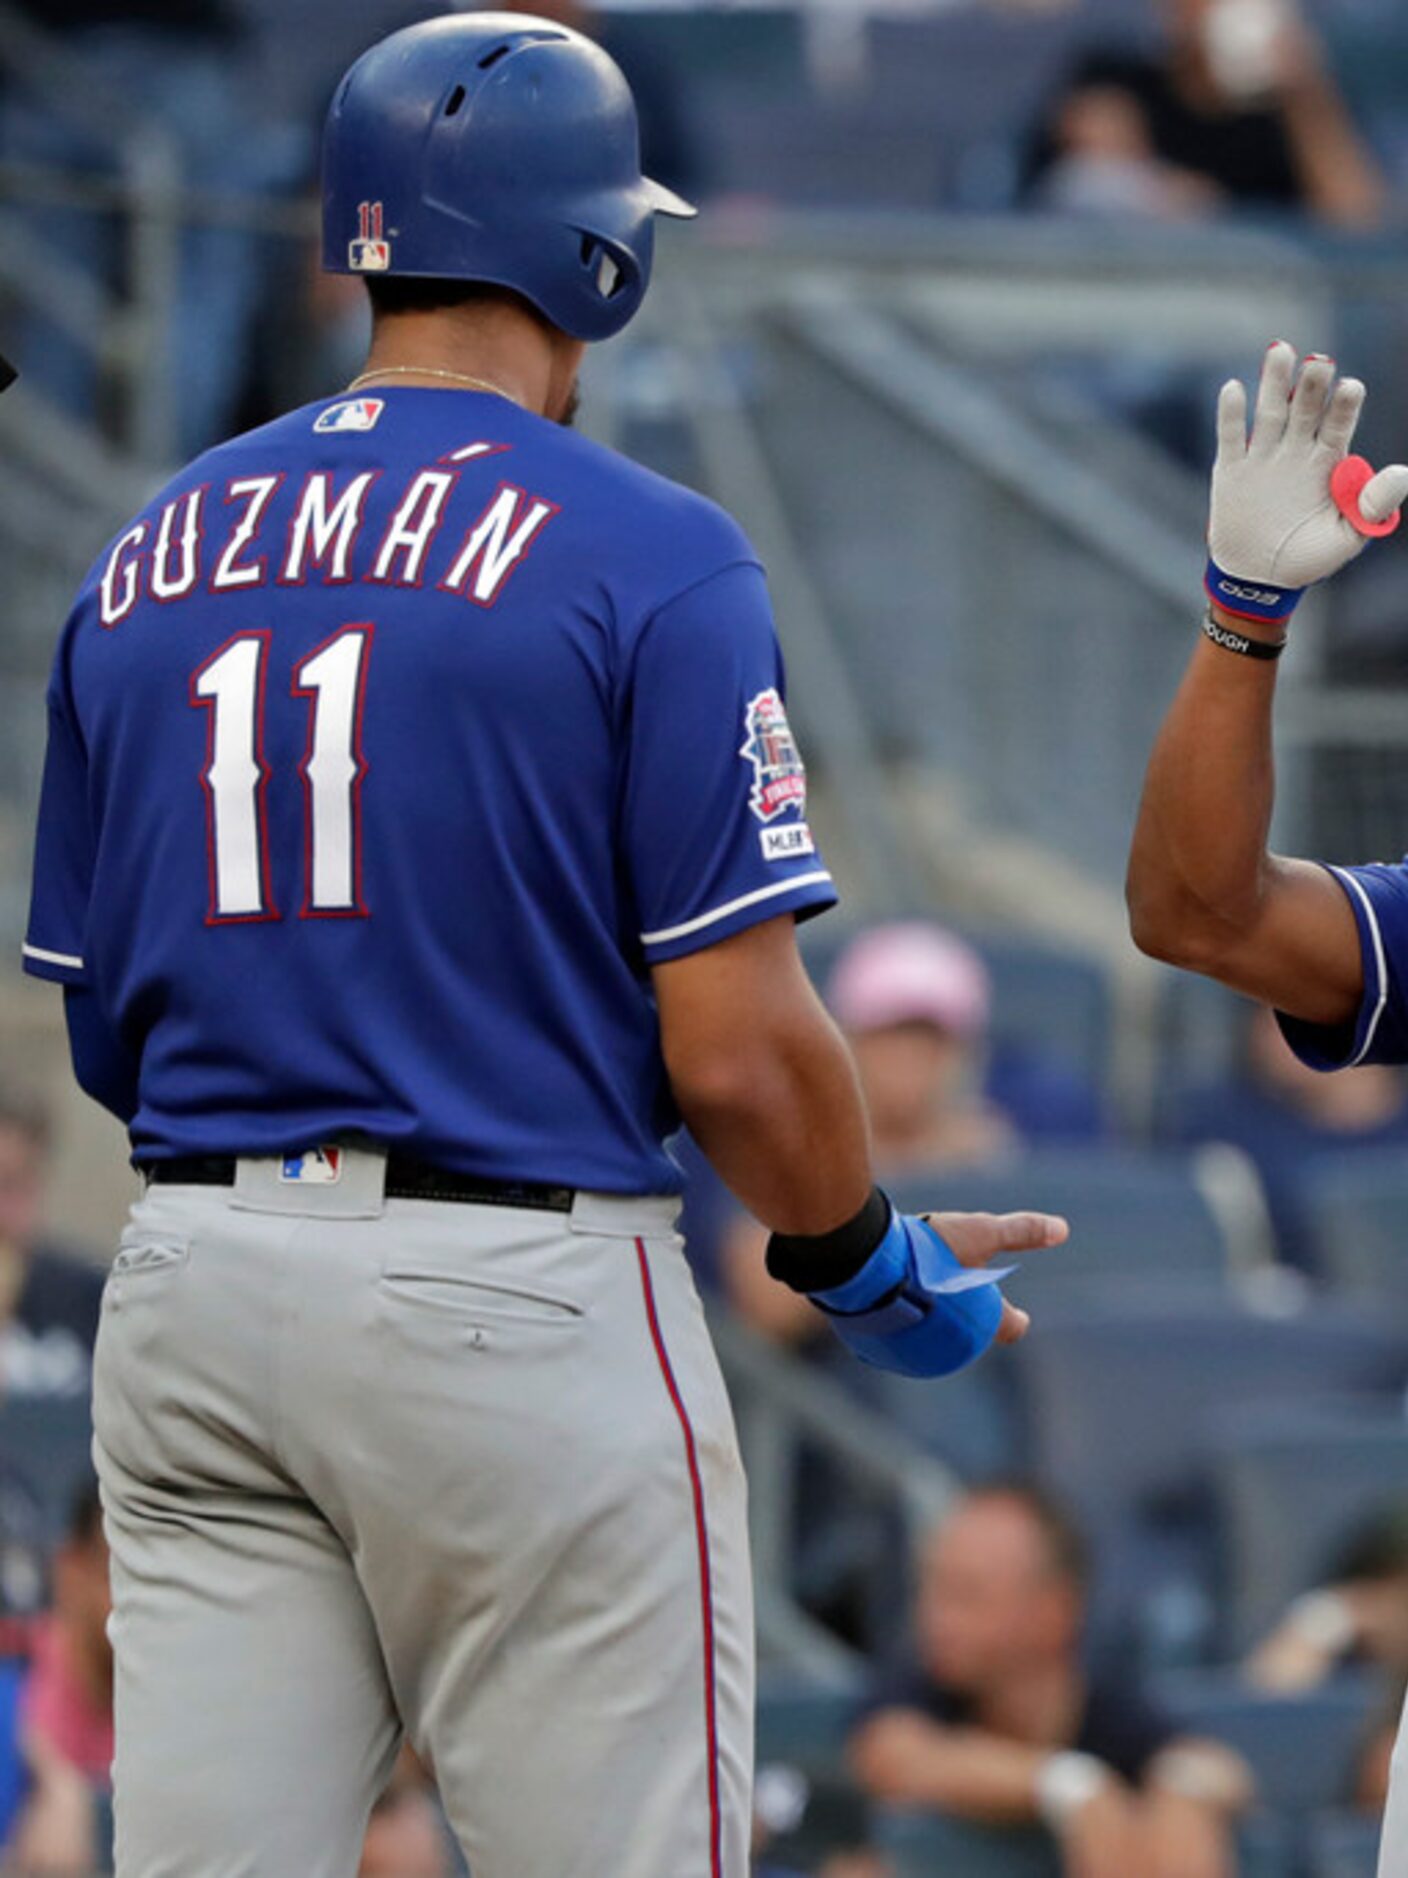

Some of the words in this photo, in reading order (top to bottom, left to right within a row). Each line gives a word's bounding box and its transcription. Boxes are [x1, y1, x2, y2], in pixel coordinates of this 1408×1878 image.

[357, 200, 383, 240] 11
[98, 440, 562, 630] GUZMÁN
[189, 622, 376, 927] 11
